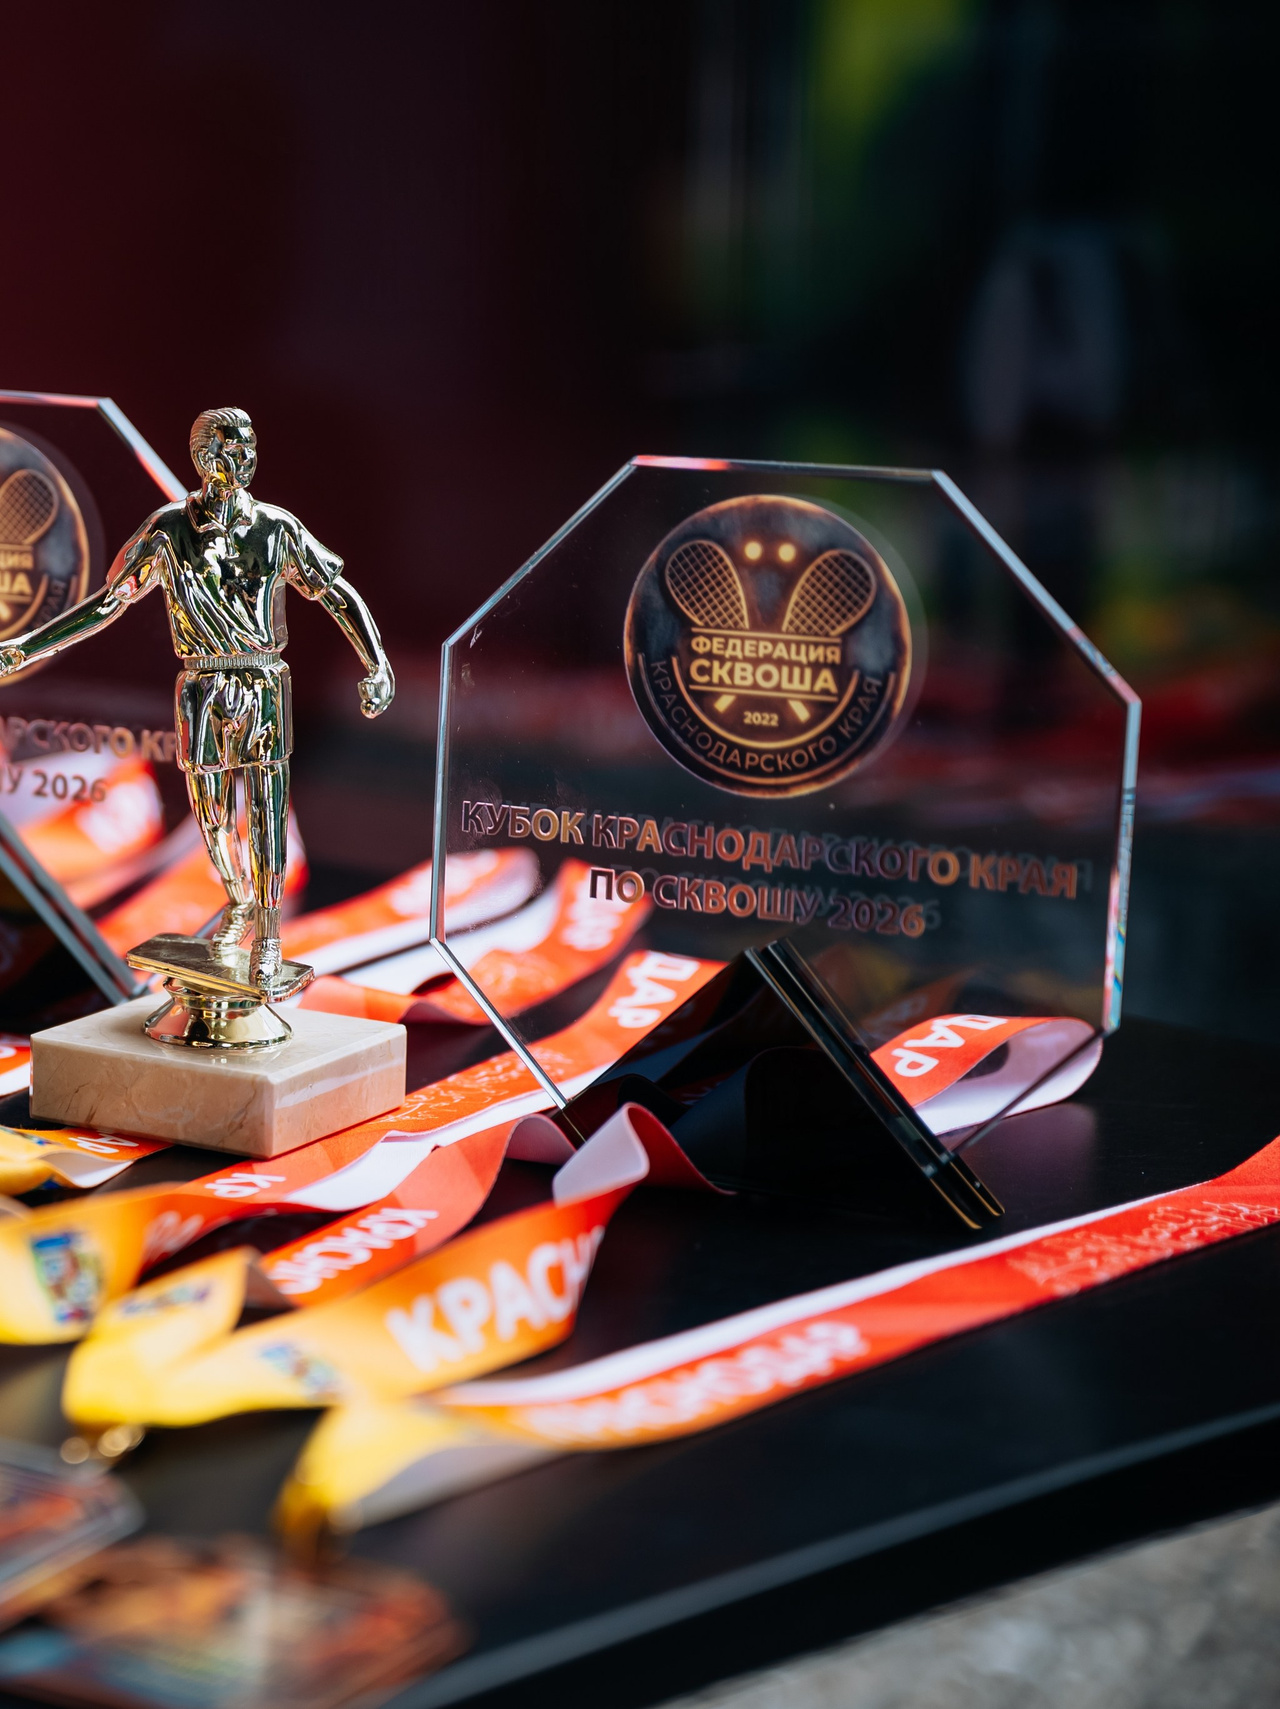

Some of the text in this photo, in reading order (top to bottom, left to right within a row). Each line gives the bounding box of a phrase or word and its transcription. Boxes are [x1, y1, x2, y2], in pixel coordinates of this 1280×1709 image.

[691, 635, 842, 665] ФЕДЕРАЦИЯ
[689, 658, 839, 694] СКВОША
[650, 661, 883, 773] КРАСНОДАРСКОГО КРАЯ
[743, 711, 779, 727] 2022
[141, 729, 177, 762] КР
[34, 769, 108, 803] 2026
[461, 800, 1078, 899] КУБОК КРАСНОДАРСКОГО КРАЯ
[589, 866, 645, 904] ПО
[652, 875, 821, 926] СКВОШУ
[827, 896, 926, 939] 2026
[891, 1014, 1009, 1077] ДАР
